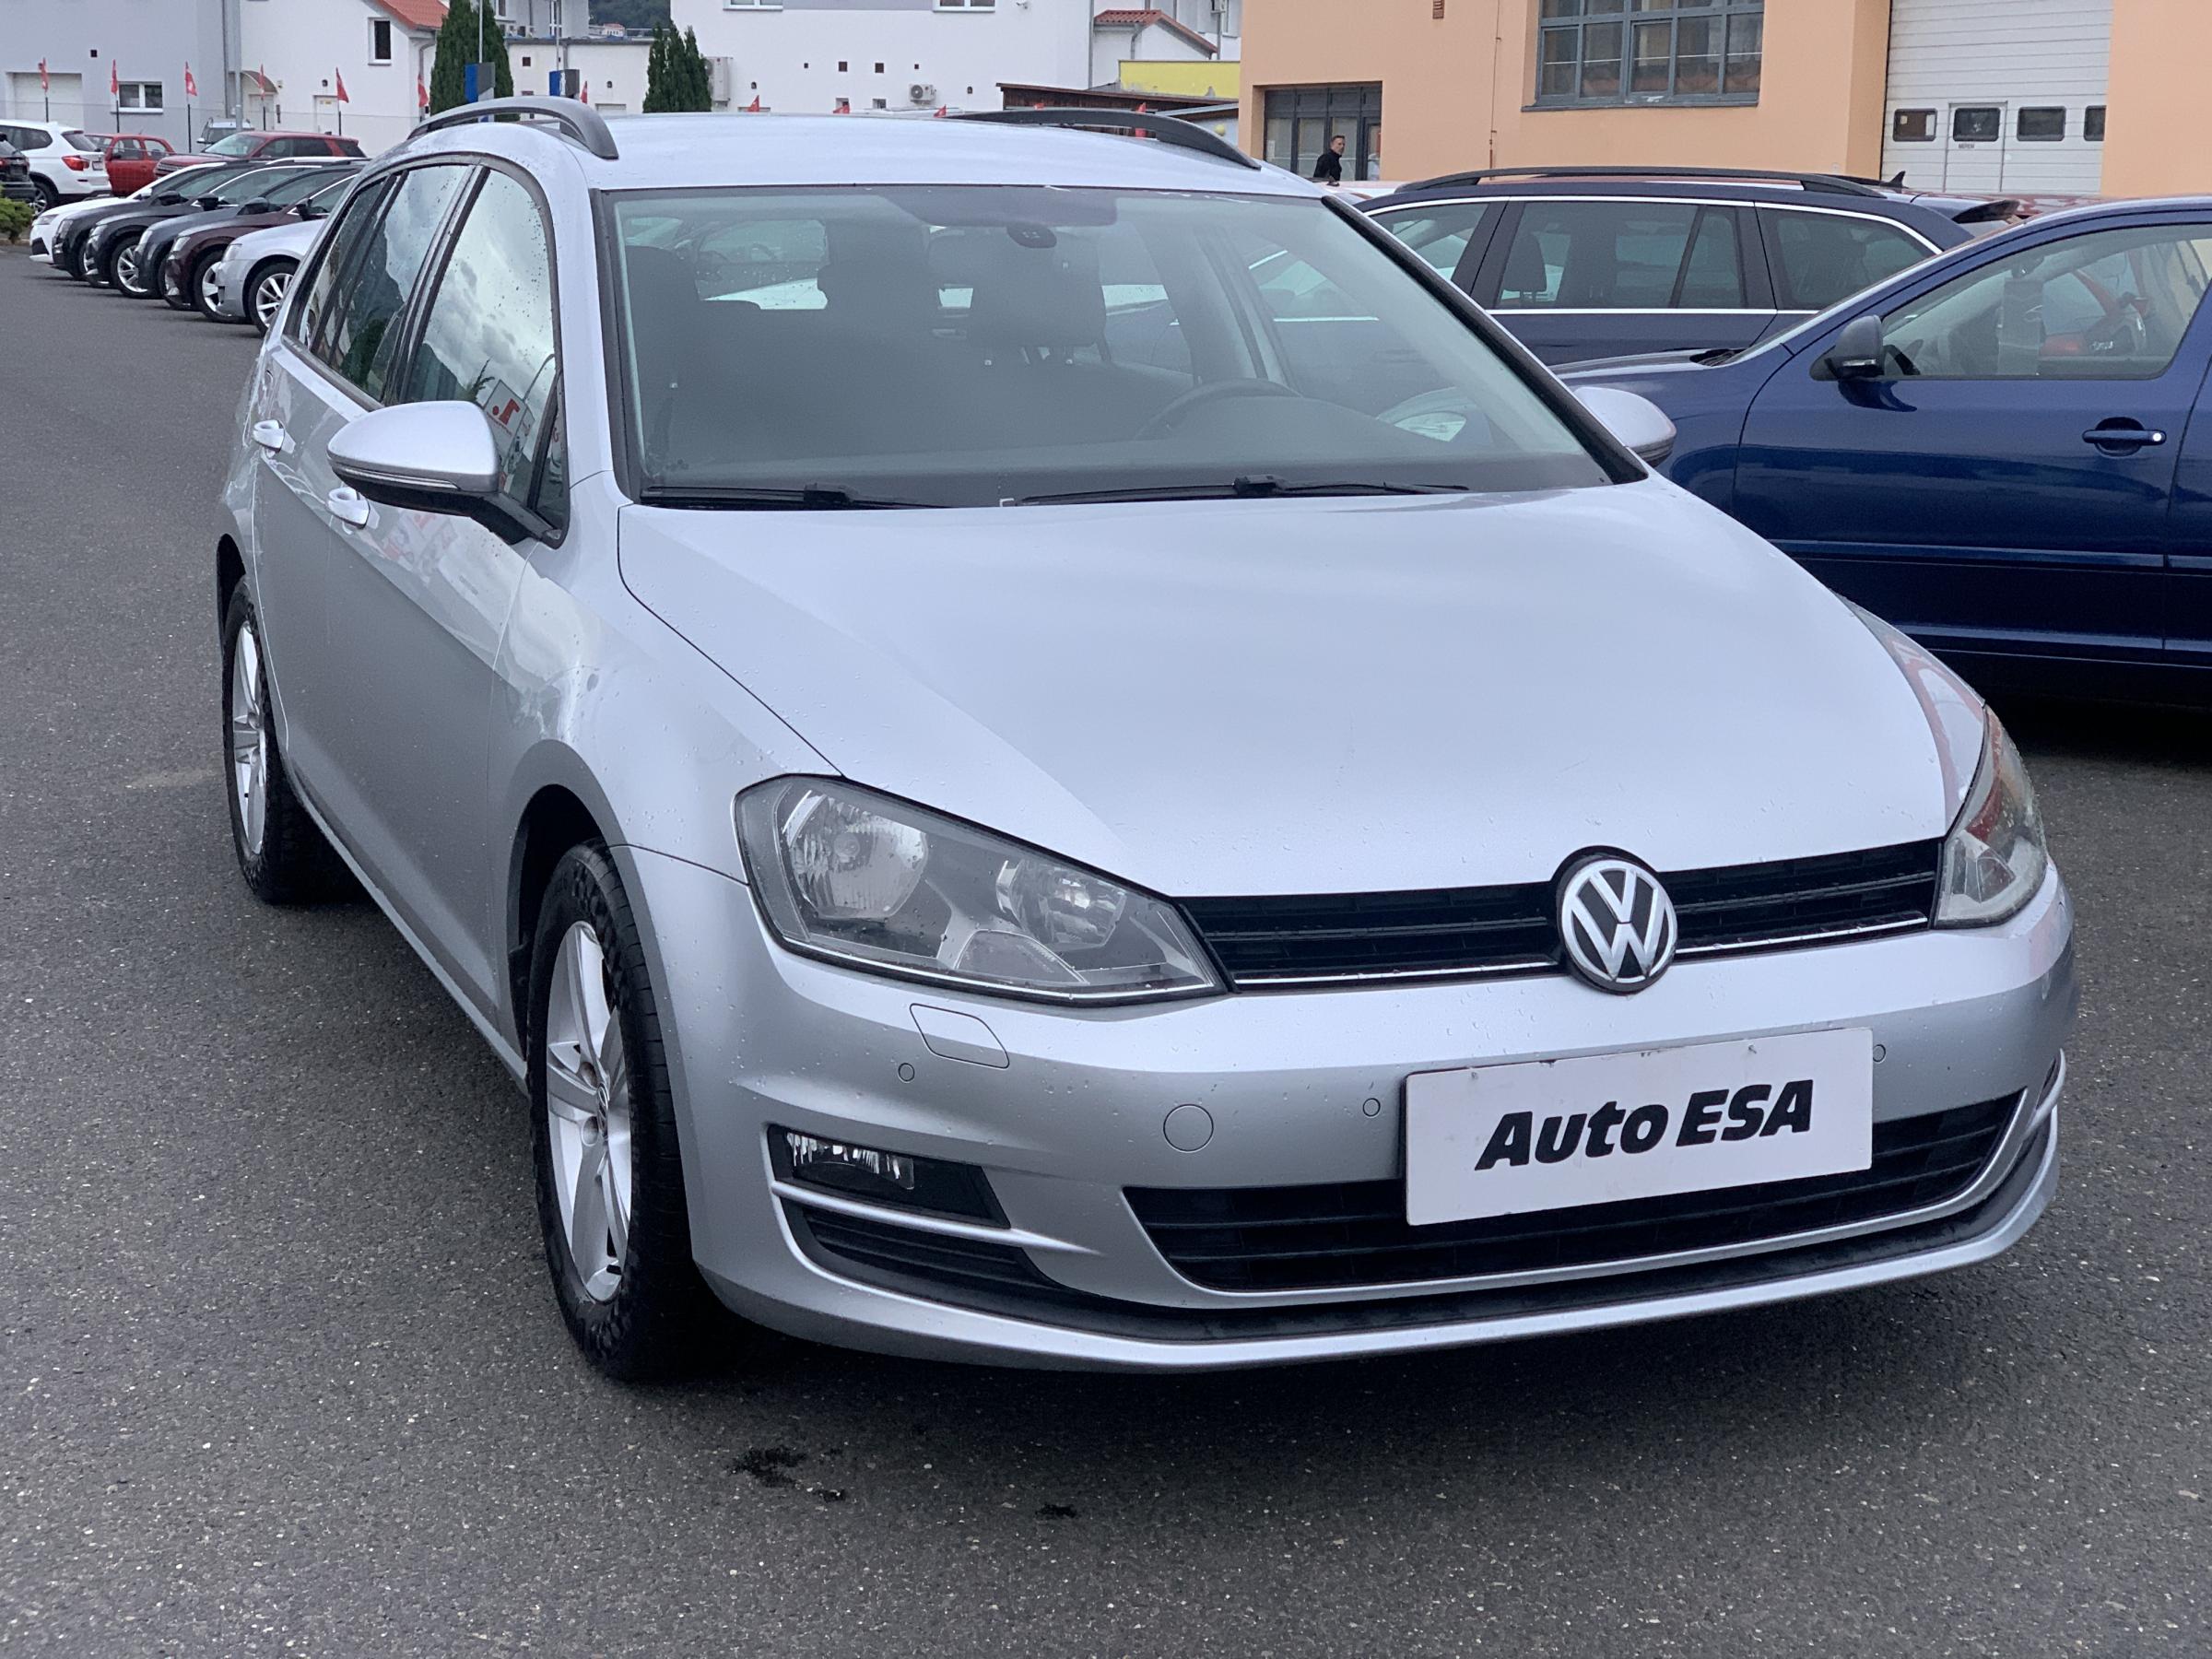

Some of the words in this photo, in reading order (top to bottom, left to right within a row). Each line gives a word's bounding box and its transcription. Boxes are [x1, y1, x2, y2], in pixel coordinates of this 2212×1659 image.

[1560, 859, 1677, 984] VW
[1475, 1101, 1668, 1171] Auto
[1677, 1080, 1813, 1147] ESA
